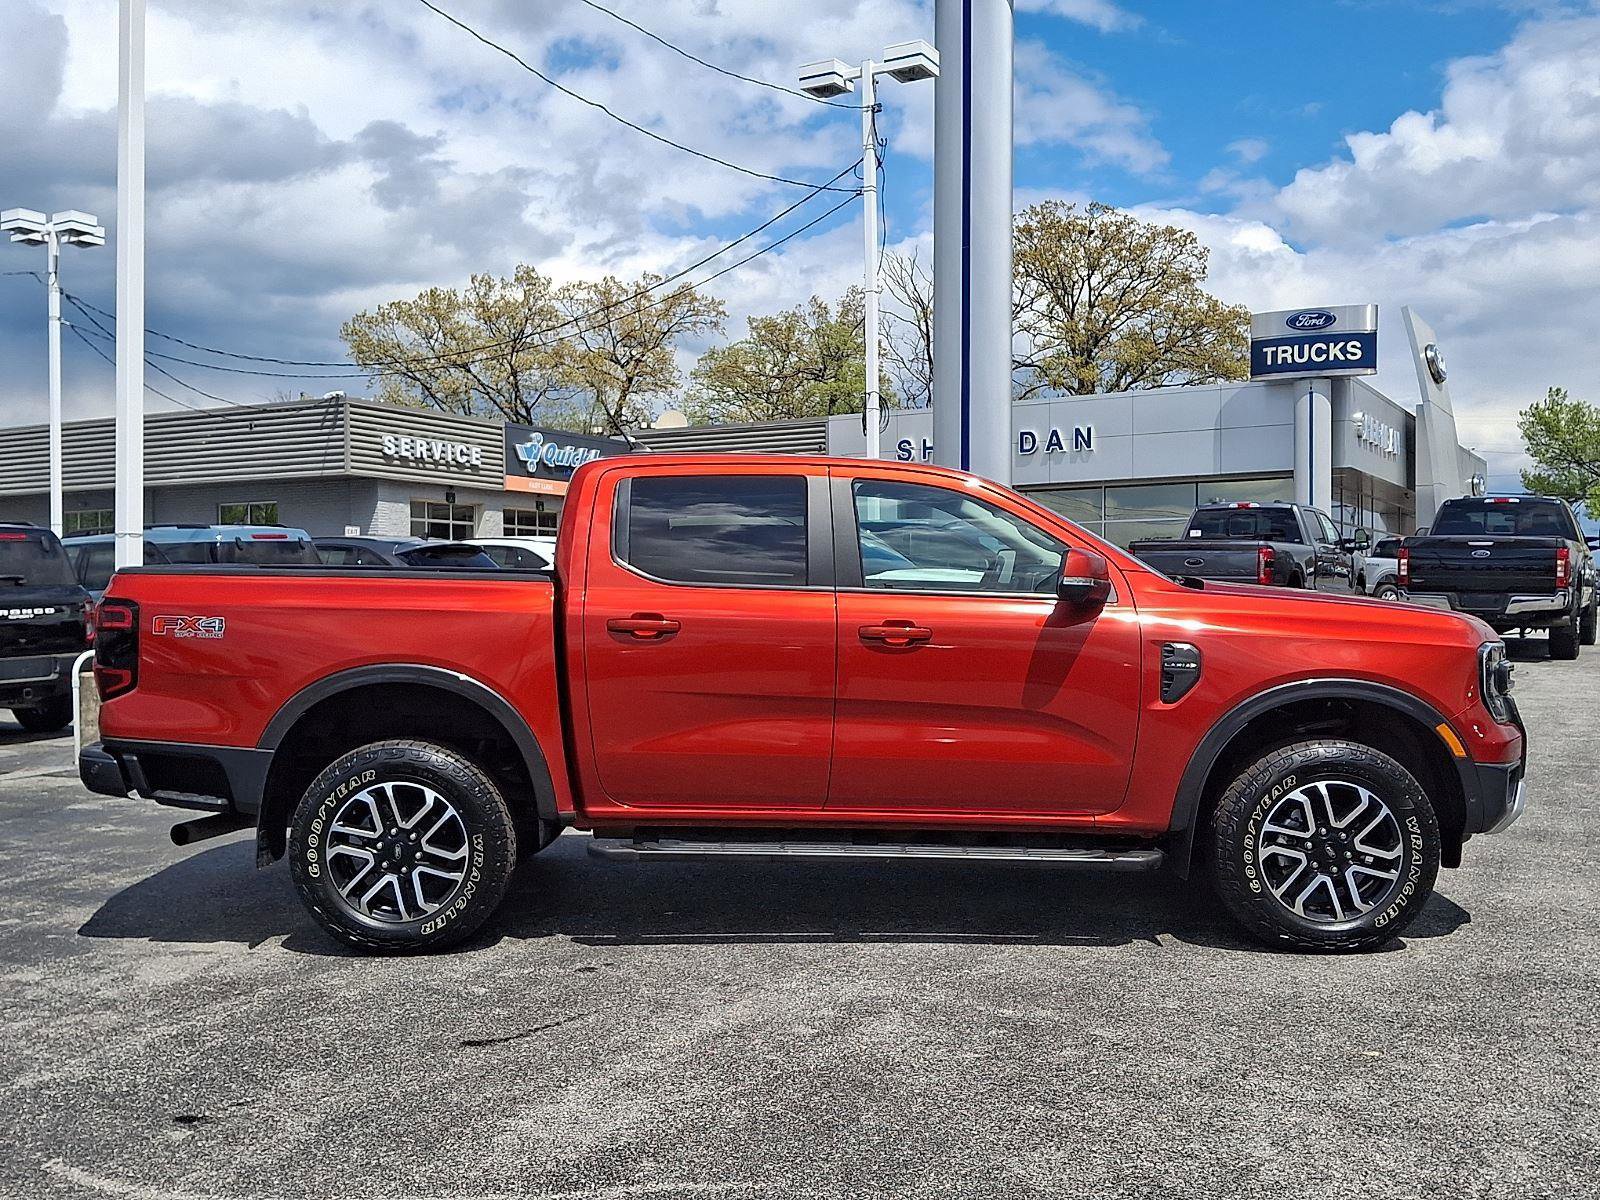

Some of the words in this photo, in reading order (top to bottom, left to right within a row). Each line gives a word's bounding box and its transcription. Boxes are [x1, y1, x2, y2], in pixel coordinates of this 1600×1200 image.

[1295, 313, 1327, 326] Ford
[1263, 341, 1363, 366] TRUCKS
[382, 434, 483, 466] SERVICE
[896, 424, 1095, 462] SHDAN
[152, 615, 226, 635] FX4
[307, 769, 376, 878] GOODYEAR
[1243, 774, 1297, 893] GOODYEAR
[420, 833, 484, 936] WRANGLER
[1375, 816, 1423, 928] WRANGLER
